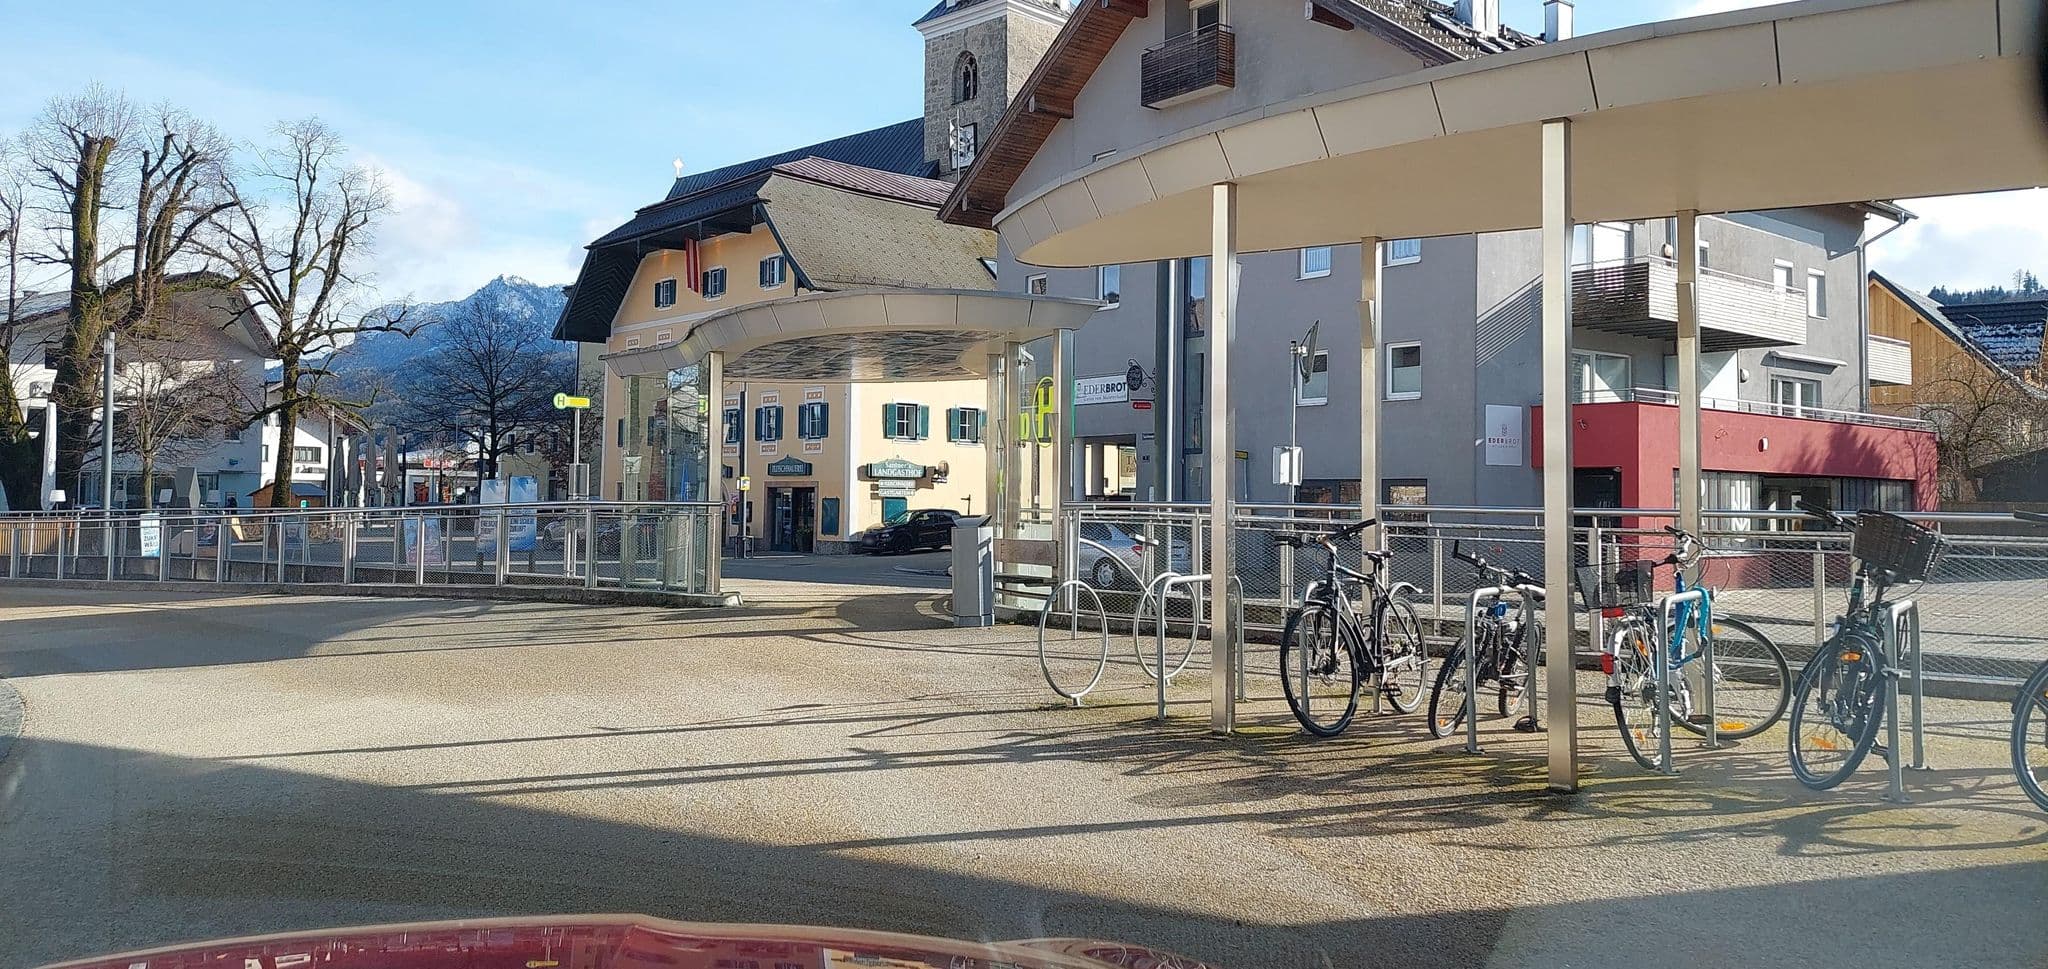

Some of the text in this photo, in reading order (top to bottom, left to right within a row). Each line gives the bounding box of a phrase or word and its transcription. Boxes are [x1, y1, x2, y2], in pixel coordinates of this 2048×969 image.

[1083, 382, 1127, 395] EDERBROT
[557, 395, 565, 406] H
[874, 468, 922, 479] LANDGASTHOF
